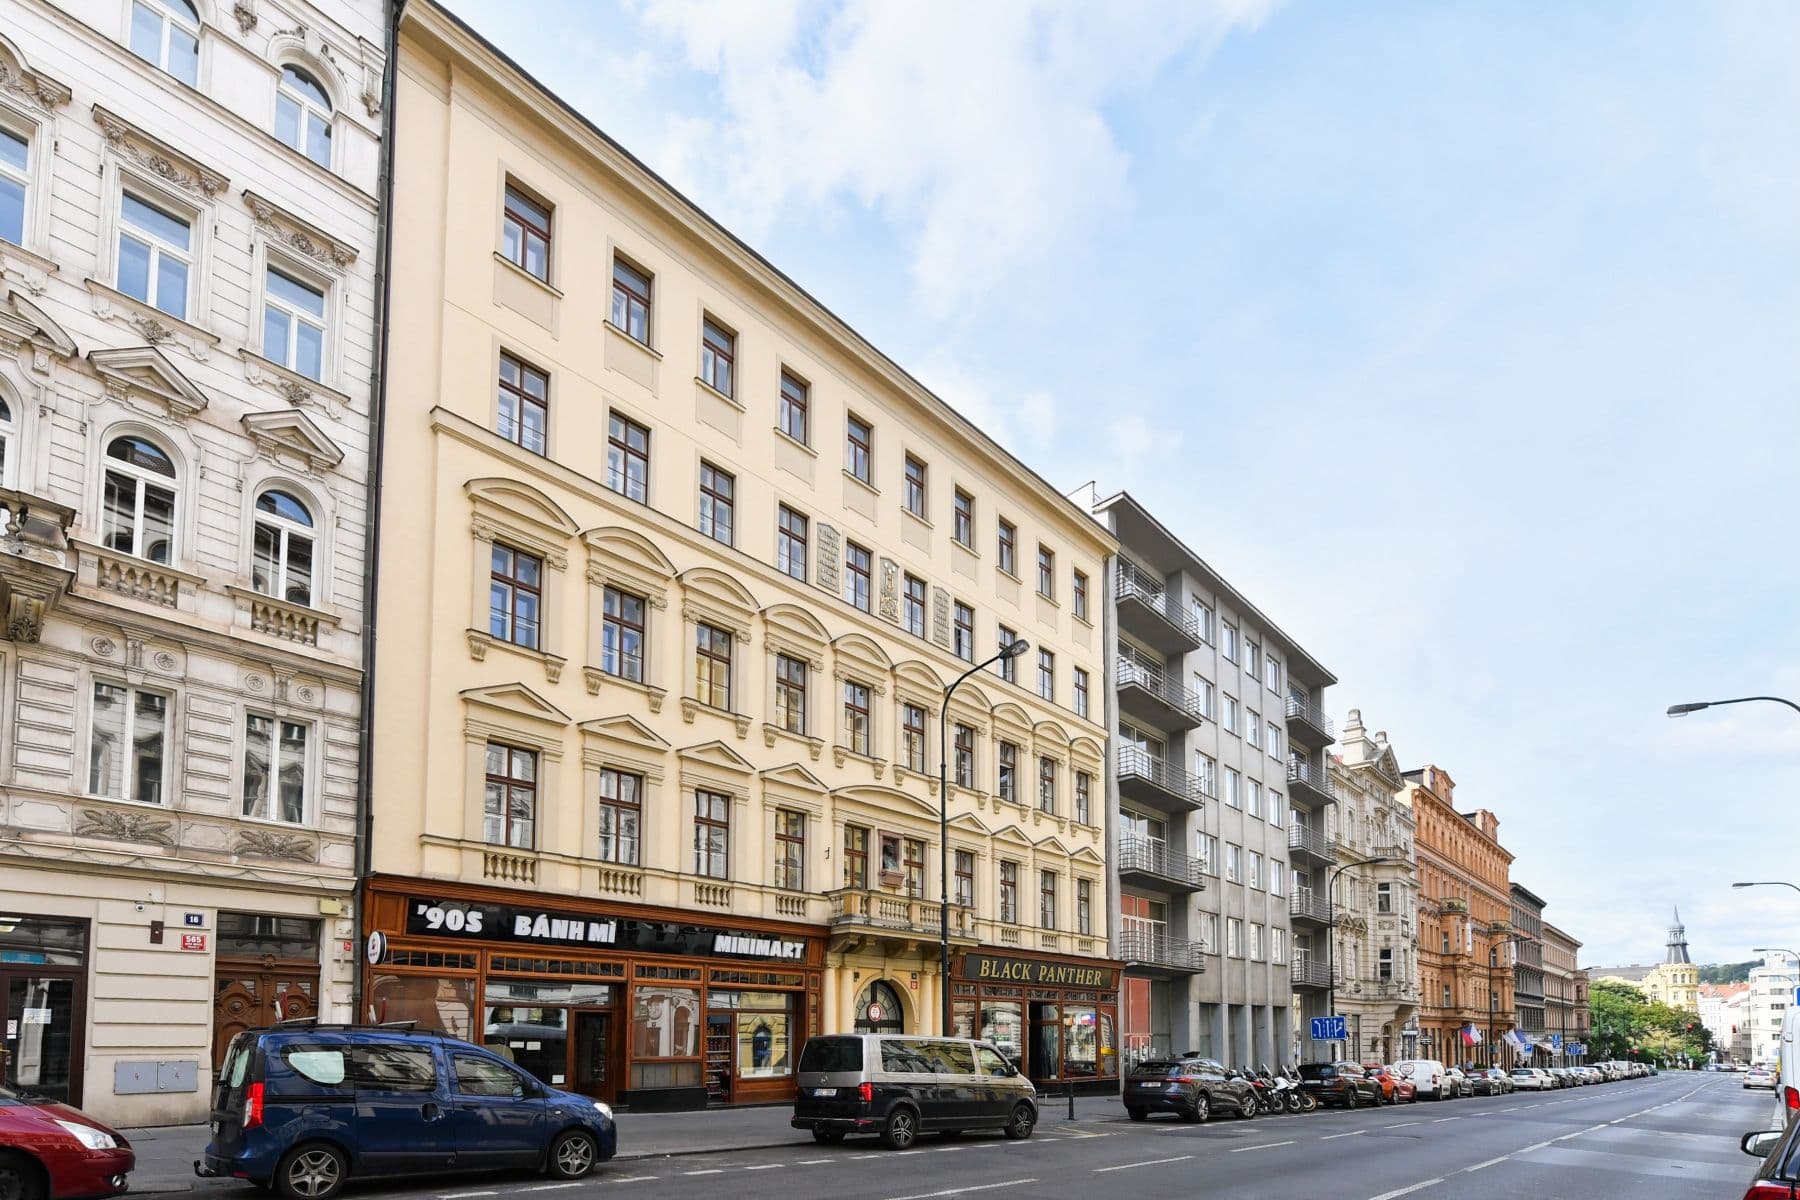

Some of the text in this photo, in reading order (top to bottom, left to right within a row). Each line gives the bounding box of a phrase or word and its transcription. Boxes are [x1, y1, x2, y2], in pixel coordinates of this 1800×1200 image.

[417, 904, 483, 933] '90S
[514, 914, 585, 941] BÁNH
[714, 934, 804, 959] MINIMART
[980, 960, 1102, 985] BLACK PANTHER
